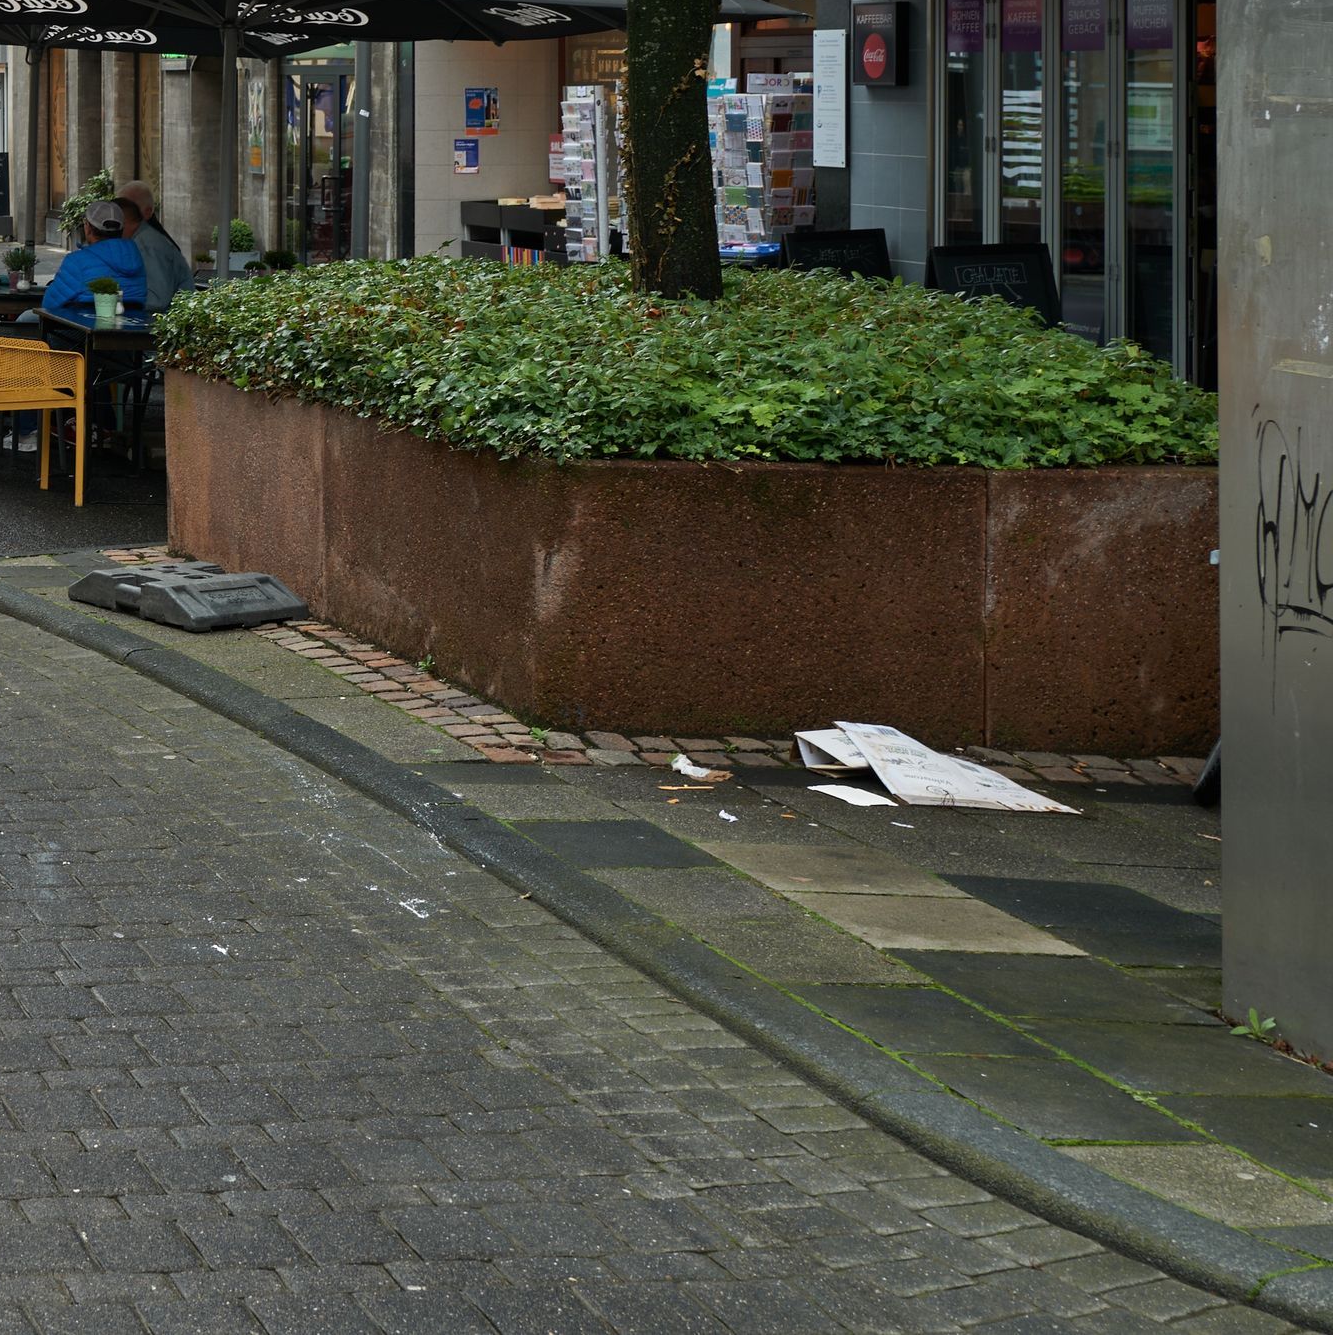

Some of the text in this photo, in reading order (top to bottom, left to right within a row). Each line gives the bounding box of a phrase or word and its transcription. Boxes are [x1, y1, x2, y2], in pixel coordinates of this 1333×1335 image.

[1068, 8, 1101, 21] SNACKS
[1132, 4, 1167, 16] MUFFINS
[856, 10, 893, 25] KAFFEEBAR
[1006, 11, 1037, 23] KAFFEE
[1132, 16, 1168, 29] KUCHEN
[951, 22, 980, 34] KAFFEE
[1068, 21, 1101, 35] GEBÄCK
